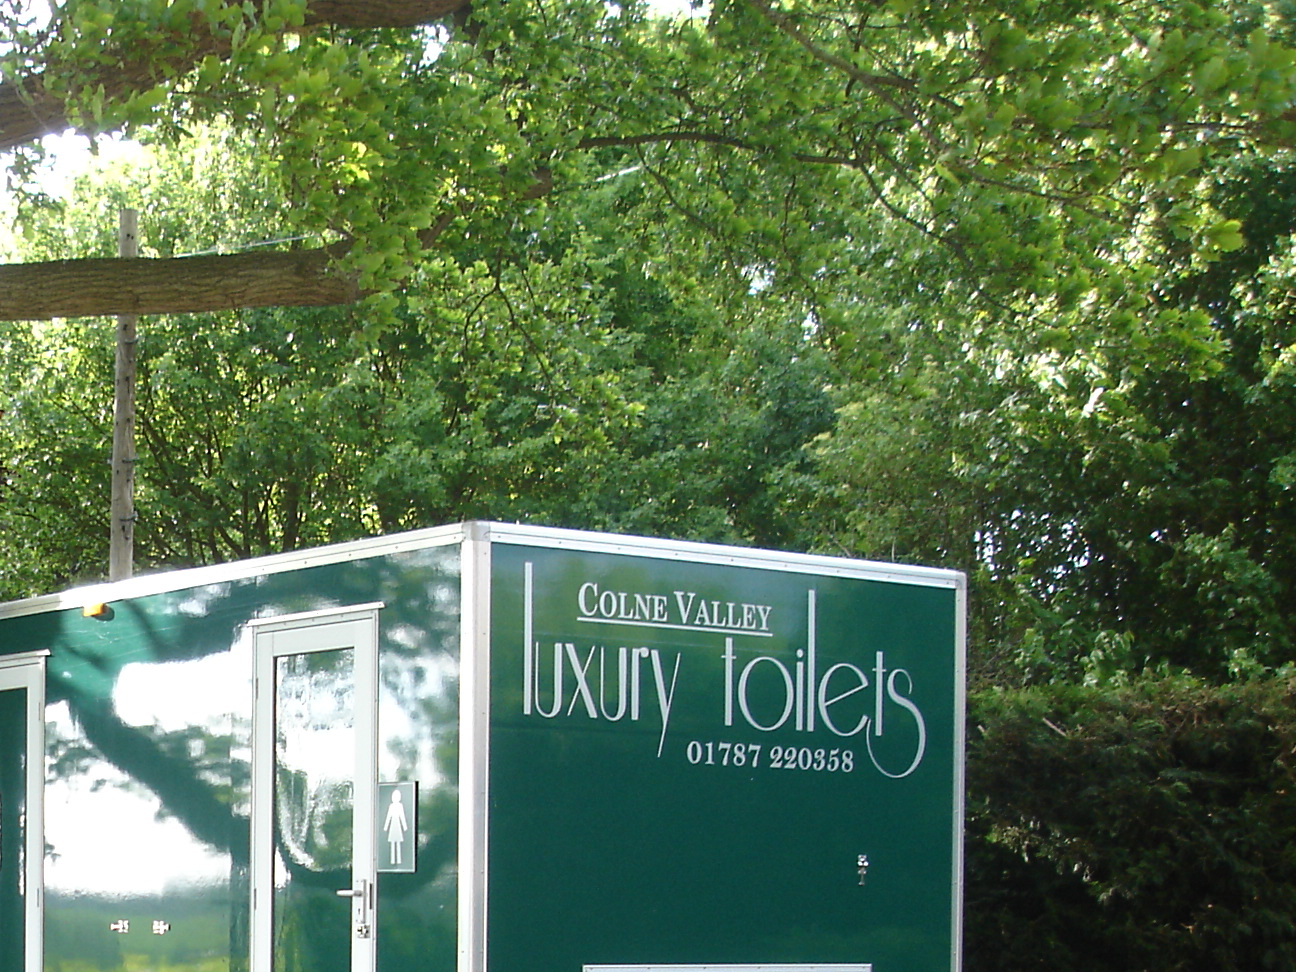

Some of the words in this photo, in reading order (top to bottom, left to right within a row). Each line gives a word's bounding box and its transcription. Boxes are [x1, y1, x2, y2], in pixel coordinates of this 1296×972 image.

[578, 583, 667, 622] COLNE
[674, 592, 772, 631] VALLEY
[524, 562, 680, 757] luxury
[721, 590, 925, 778] toilets
[687, 740, 760, 768] 01787
[769, 746, 854, 774] 220358
